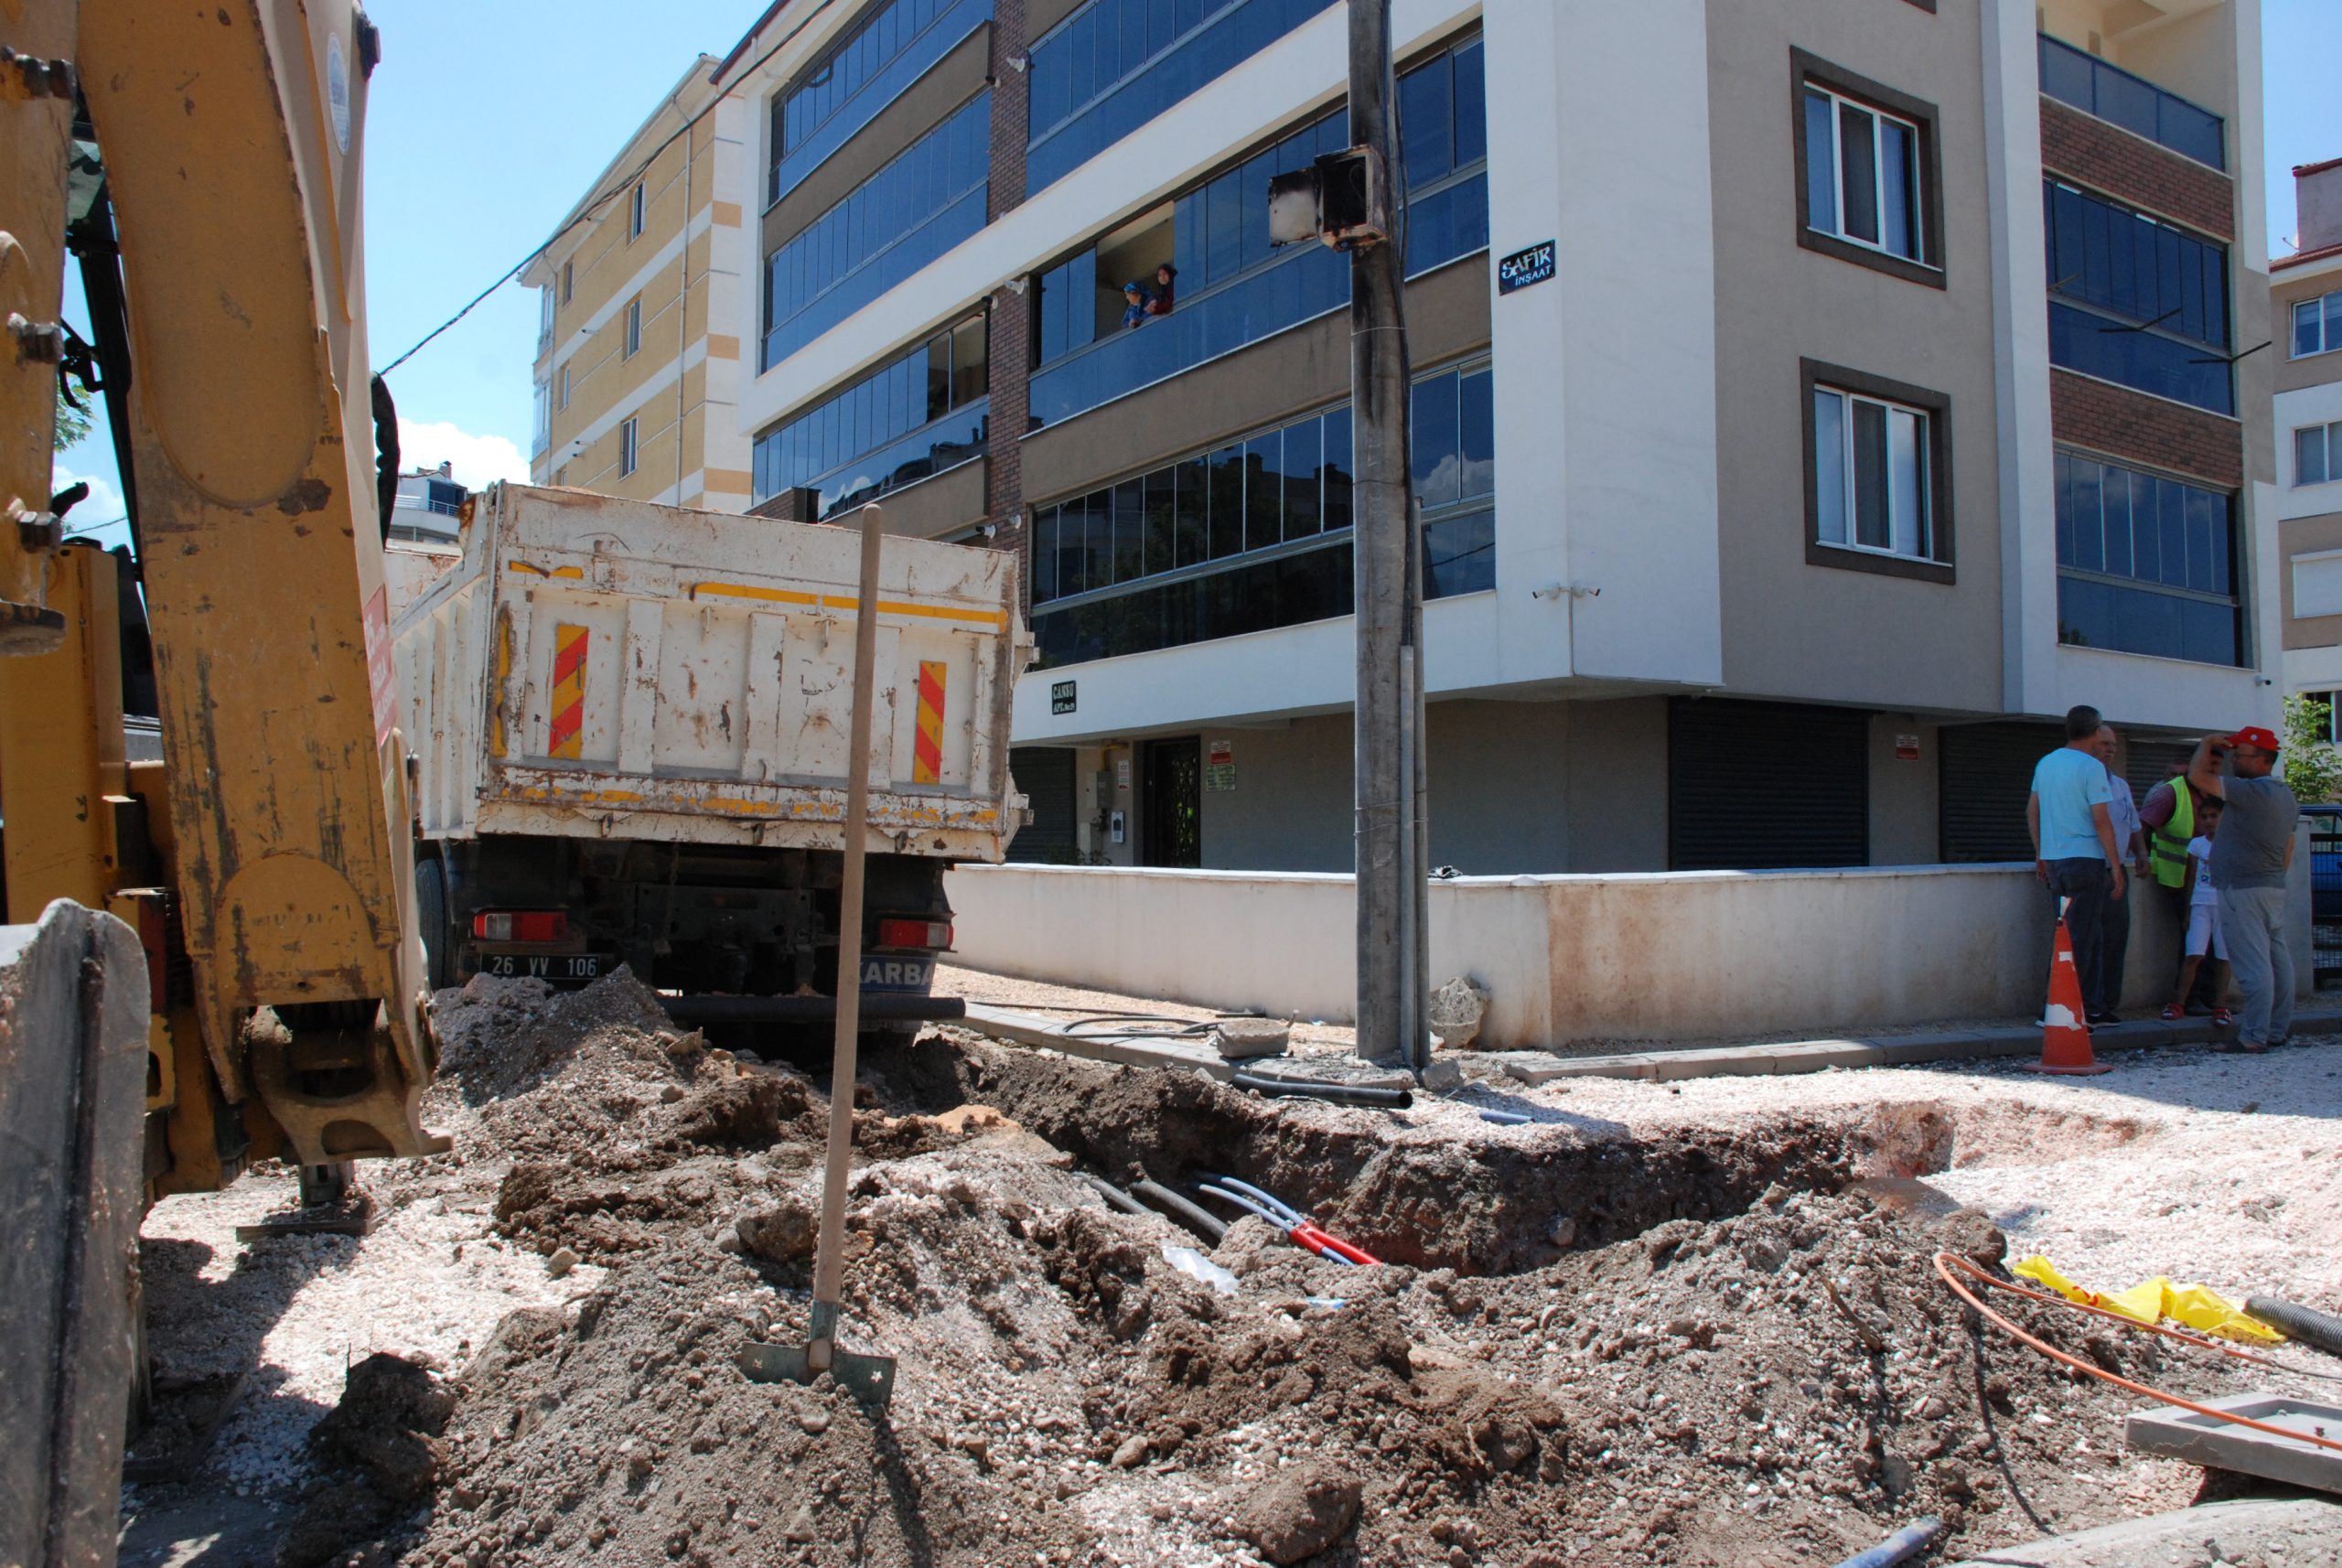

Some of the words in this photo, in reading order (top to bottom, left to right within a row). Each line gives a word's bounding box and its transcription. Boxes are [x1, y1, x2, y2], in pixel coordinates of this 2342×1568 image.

[1501, 245, 1552, 279] SAFİR
[492, 956, 513, 975] 26
[529, 957, 550, 976] VV
[568, 958, 597, 977] 106
